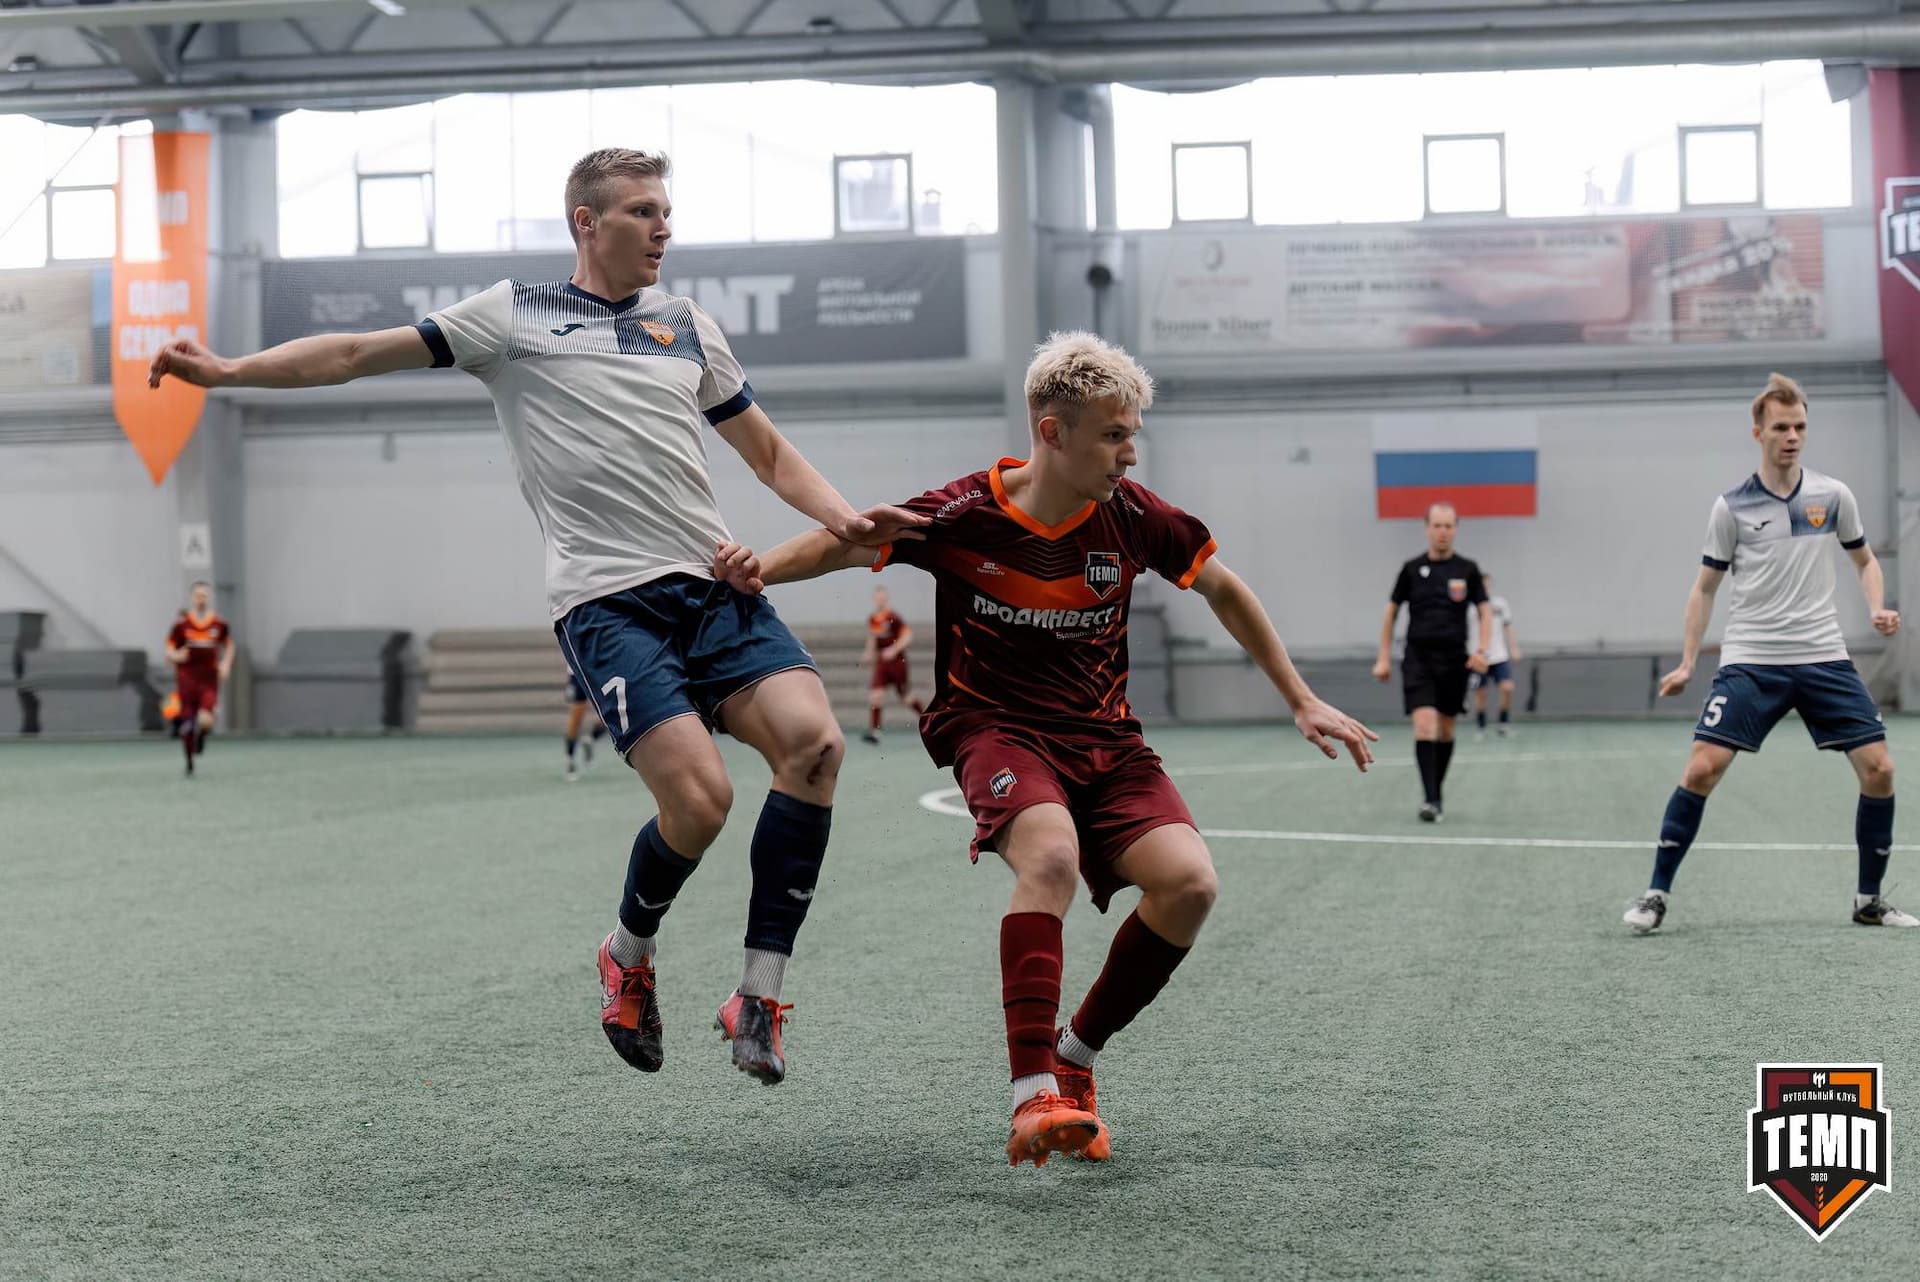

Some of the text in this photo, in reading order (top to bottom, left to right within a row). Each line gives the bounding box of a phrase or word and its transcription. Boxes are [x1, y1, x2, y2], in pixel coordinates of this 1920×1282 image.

[1089, 565, 1119, 583] ТЕМП
[973, 594, 1116, 630] ПРОДИНВЕСТ
[601, 676, 629, 735] 7
[1703, 695, 1728, 728] 5
